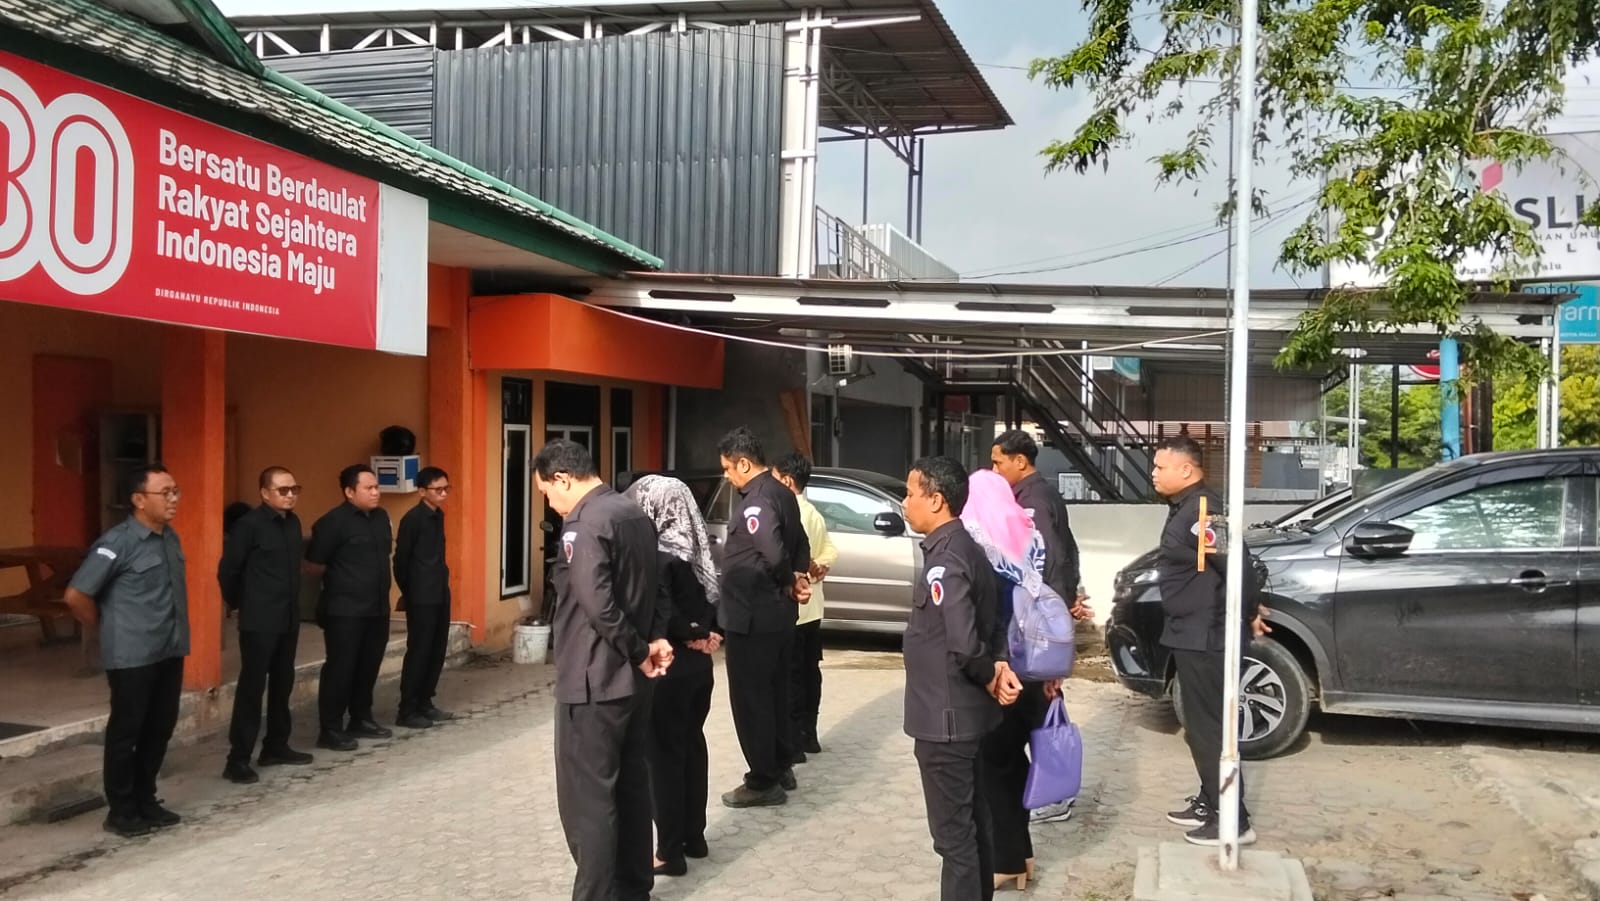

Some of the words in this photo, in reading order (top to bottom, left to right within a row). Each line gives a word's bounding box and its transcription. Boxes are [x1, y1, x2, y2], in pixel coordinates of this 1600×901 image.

[159, 128, 260, 192] Bersatu
[267, 163, 367, 222] Berdaulat
[158, 174, 249, 231] Rakyat
[255, 202, 357, 257] Sejahtera
[157, 220, 281, 279] Indonesia
[287, 250, 336, 295] Maju
[155, 287, 201, 303] DIRGAHAYU
[203, 295, 240, 309] REPUBLIK
[242, 302, 280, 315] INDONESIA
